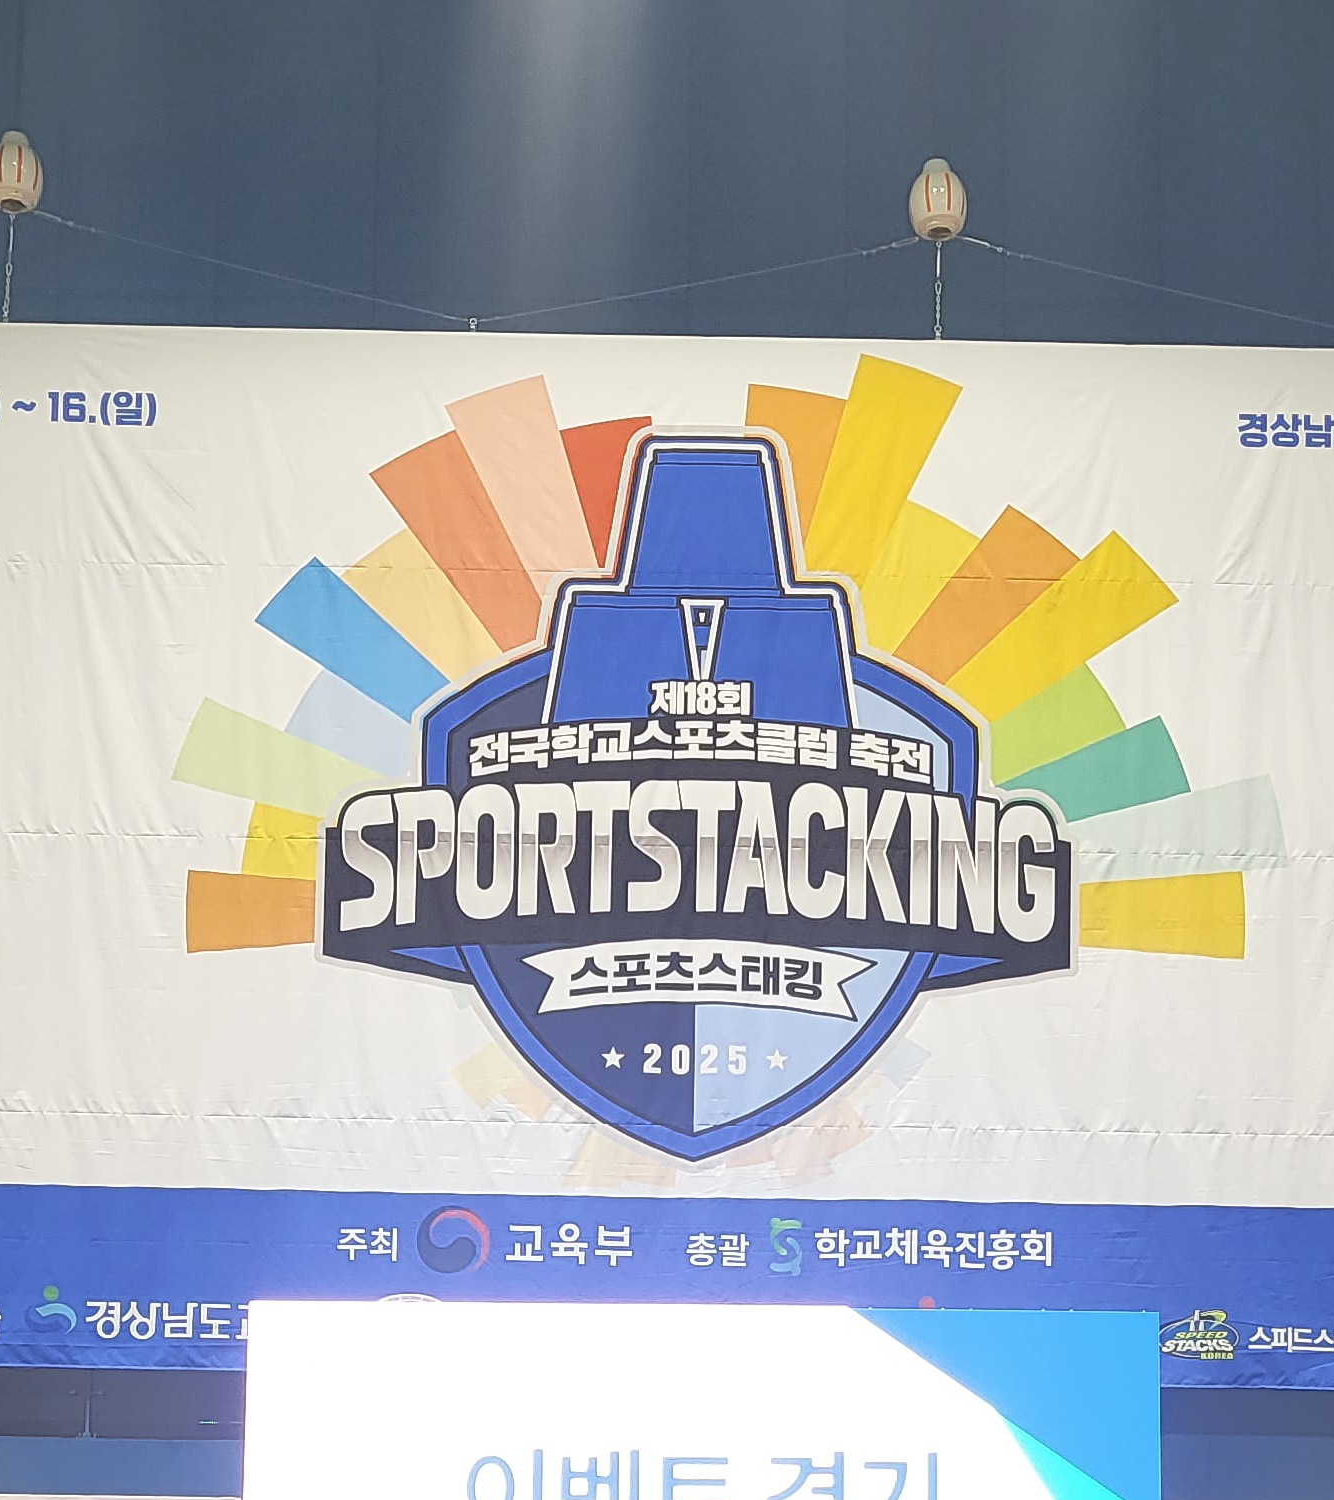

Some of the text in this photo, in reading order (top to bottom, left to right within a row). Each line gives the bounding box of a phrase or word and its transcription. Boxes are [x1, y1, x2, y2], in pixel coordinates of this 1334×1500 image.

[48, 390, 157, 427] 16.(일)
[651, 680, 752, 717] 제18회
[468, 721, 933, 784] 전국학교스포츠클럽 축전
[339, 779, 1057, 943] SPORTSTACKING
[569, 952, 824, 1001] 스포츠스태킹
[642, 1042, 749, 1076] 2025
[336, 1222, 1054, 1271] 주최 교육부 총괄 학교체육진흥회
[85, 1299, 249, 1341] 경상남도
[1174, 1330, 1228, 1340] SPEED
[1161, 1338, 1234, 1353] STACKS
